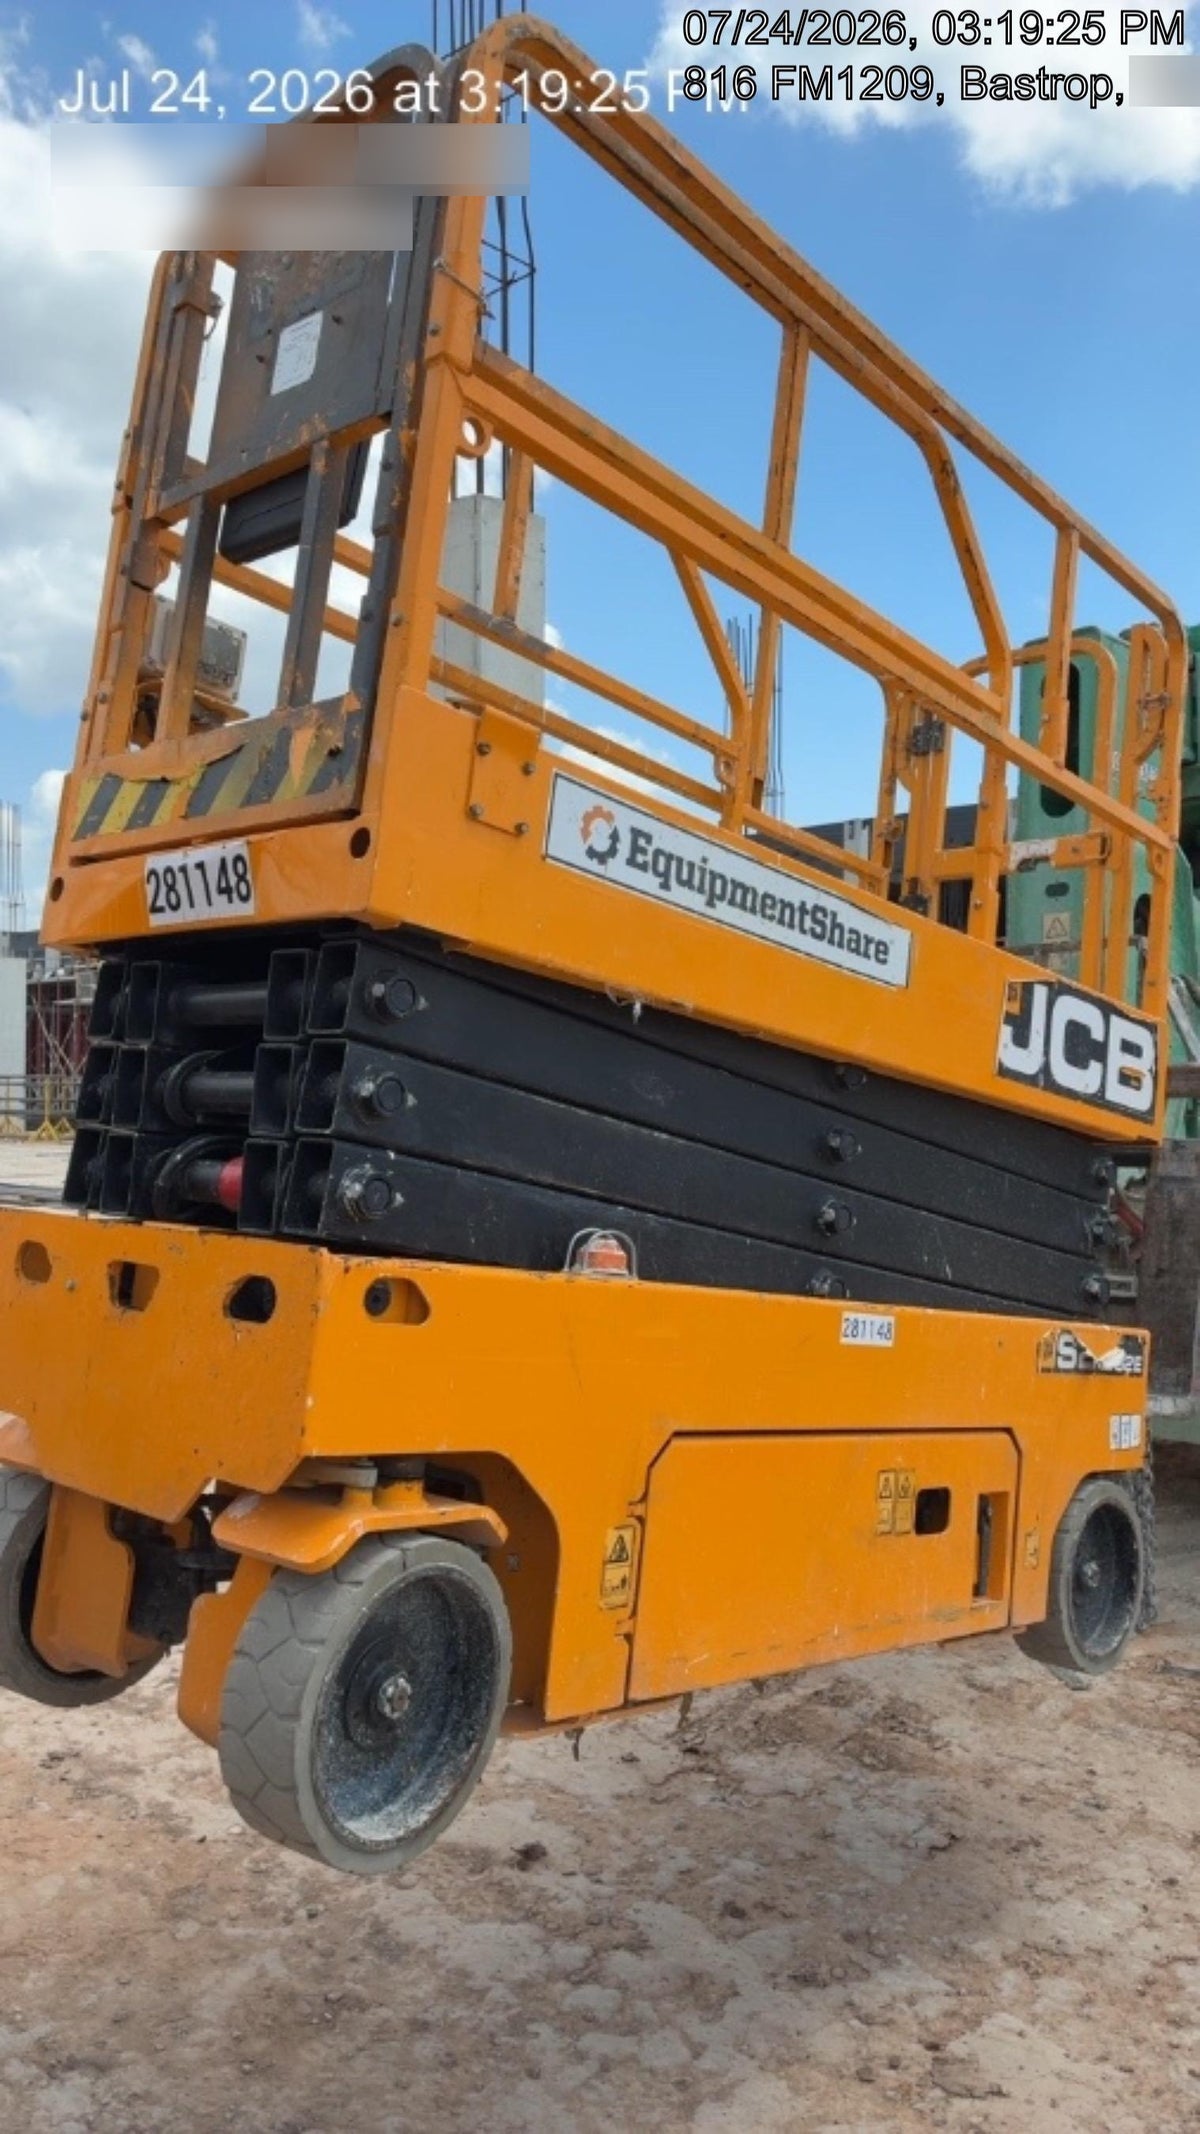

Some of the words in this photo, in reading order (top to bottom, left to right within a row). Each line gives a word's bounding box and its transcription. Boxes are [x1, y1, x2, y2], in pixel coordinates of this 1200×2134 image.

[146, 852, 252, 914] 281148
[625, 826, 890, 967] EquipmentShare
[998, 982, 1156, 1113] JCB
[843, 1317, 893, 1341] 281148
